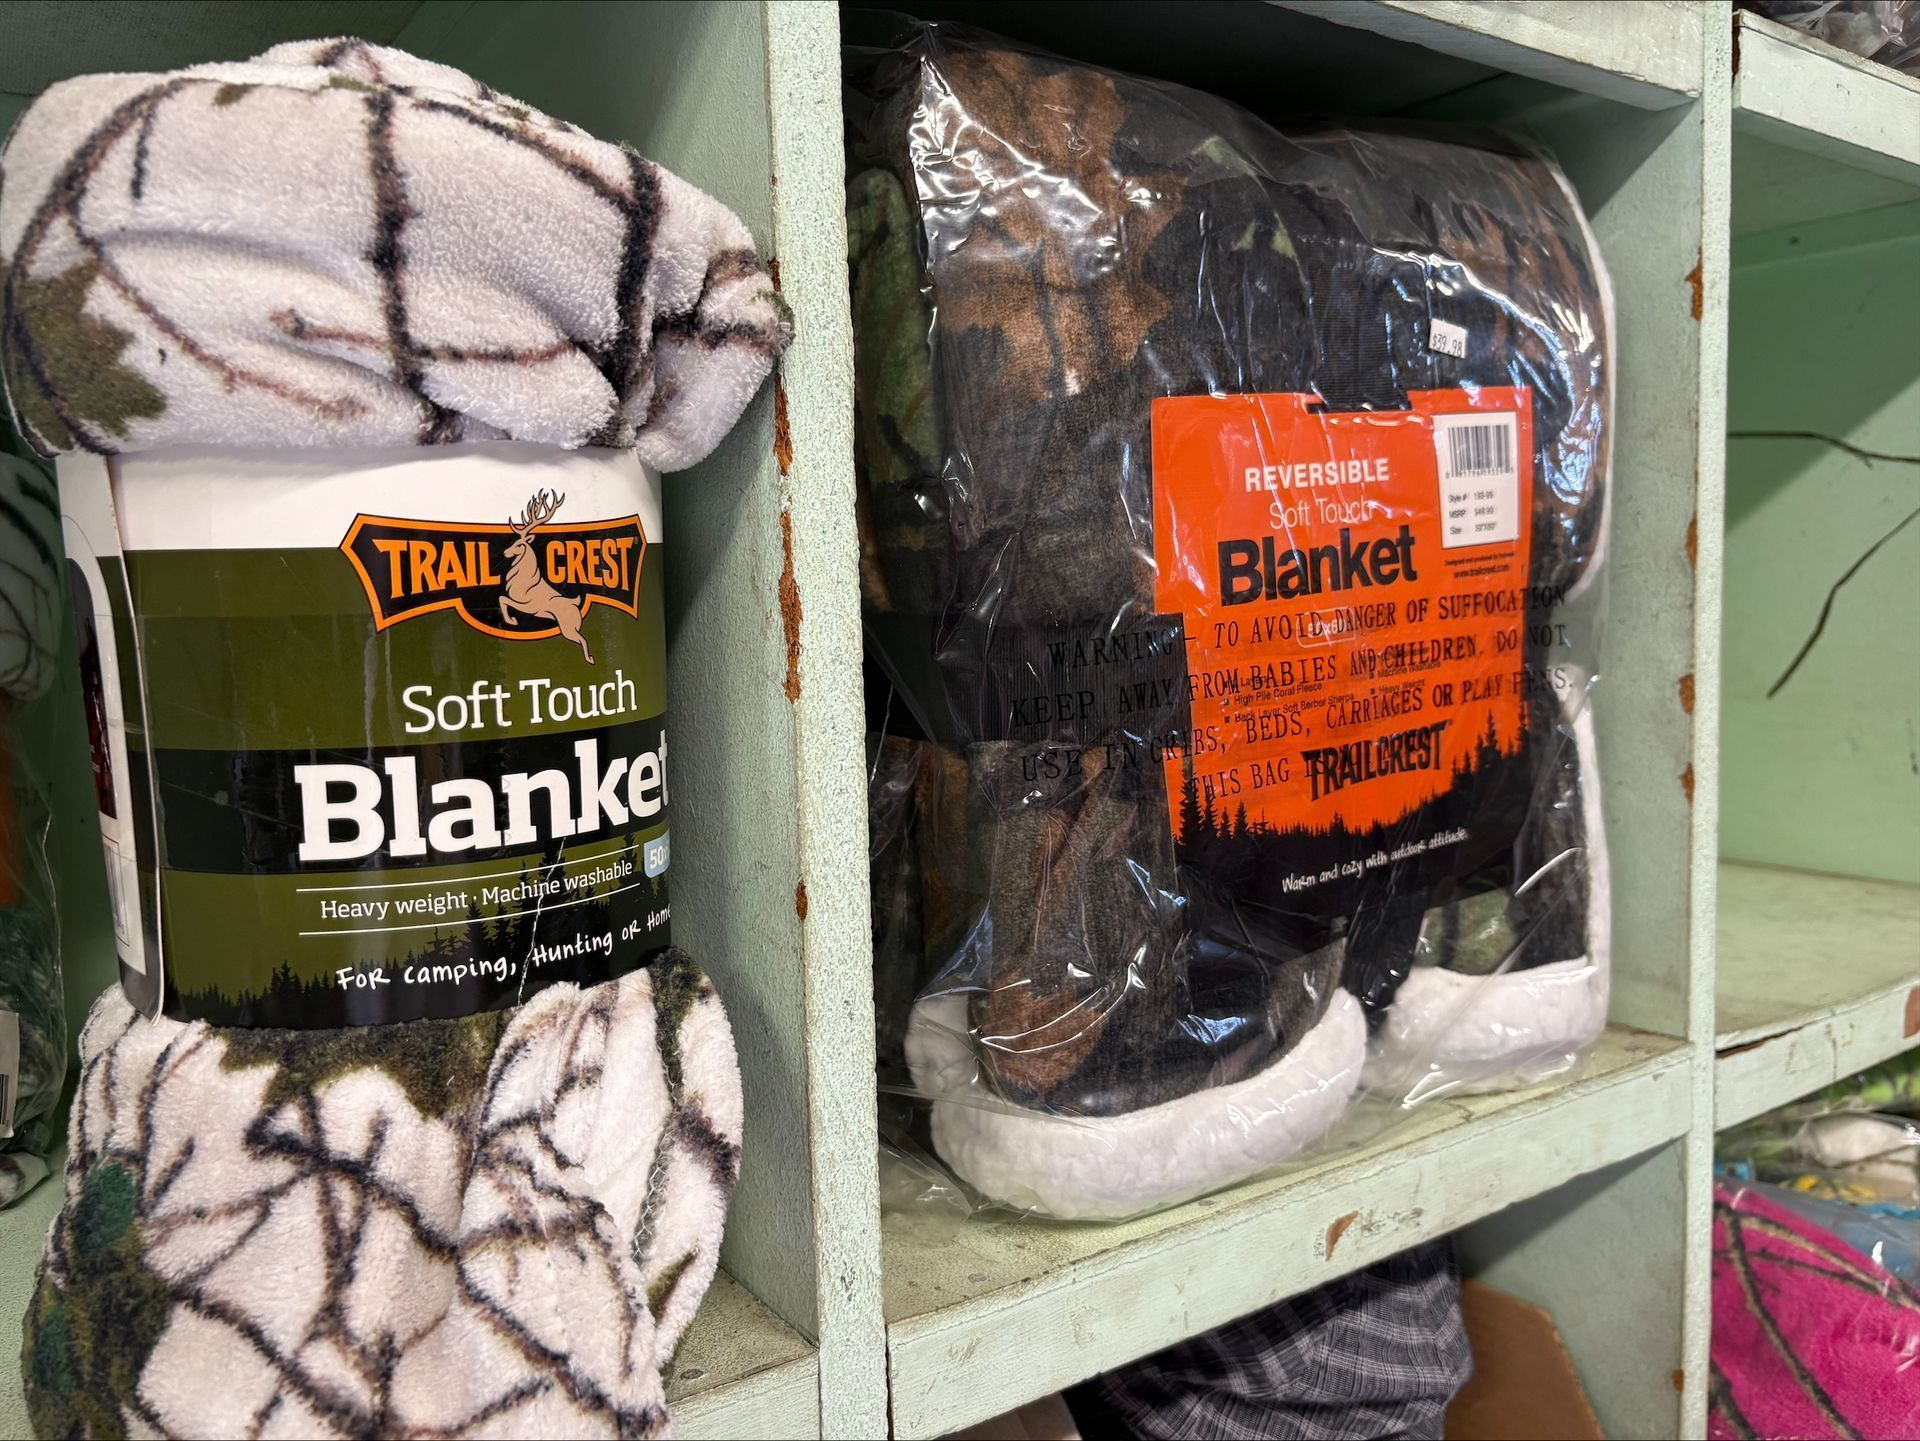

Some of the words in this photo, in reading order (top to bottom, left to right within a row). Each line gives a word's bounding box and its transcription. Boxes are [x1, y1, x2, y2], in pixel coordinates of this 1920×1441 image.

[1432, 333, 1463, 357] $39.98
[1244, 458, 1390, 492] REVERSIBLE
[1270, 498, 1310, 529] Soft
[1315, 496, 1374, 525] Touch
[372, 538, 501, 599] TRAIL
[546, 537, 635, 592] CREST
[1218, 525, 1418, 607] Blanket
[1047, 628, 1174, 671] WARNING
[1214, 621, 1239, 648] TO
[1251, 612, 1323, 644] AVOID
[1335, 602, 1396, 634] DANGER
[1407, 598, 1429, 624] OF
[1439, 586, 1567, 621] SUFFOCATION
[402, 680, 513, 733] Soft
[518, 669, 638, 725] Touch
[1011, 690, 1095, 728] KEEP
[1187, 668, 1240, 701] FROM
[1250, 655, 1337, 691] BABIES
[1350, 648, 1377, 677] AND
[1496, 628, 1518, 653] DO
[1529, 624, 1567, 647] NOT
[1234, 694, 1254, 706] High
[1256, 690, 1271, 700] Pile
[1274, 686, 1295, 698] Coral
[1297, 682, 1322, 694] Fleece
[1021, 750, 1083, 782] USE
[1103, 743, 1137, 770] IN
[1150, 725, 1226, 764] CRIBS,
[1246, 711, 1312, 744] BEDS,
[1327, 686, 1422, 728] CARRIAGES
[1433, 683, 1454, 708] OR
[1458, 673, 1504, 703] PLAY
[1235, 711, 1255, 723] Back
[1283, 703, 1298, 714] Soft
[1301, 698, 1326, 710] Berber
[1189, 768, 1242, 801] THIS
[1250, 757, 1291, 789] BAG
[1300, 719, 1448, 801] TRAILCREST
[293, 729, 669, 863] Blanket
[320, 899, 390, 921] Heavy
[394, 891, 468, 915] weight
[482, 877, 561, 906] Machine
[563, 860, 633, 891] washable
[1282, 872, 1316, 894] Warm
[1319, 863, 1338, 883] and
[1341, 859, 1363, 879] cozy
[1365, 851, 1389, 869] with
[1390, 840, 1427, 861] outdoor
[404, 956, 517, 986] camping,
[532, 931, 613, 967] Hunting
